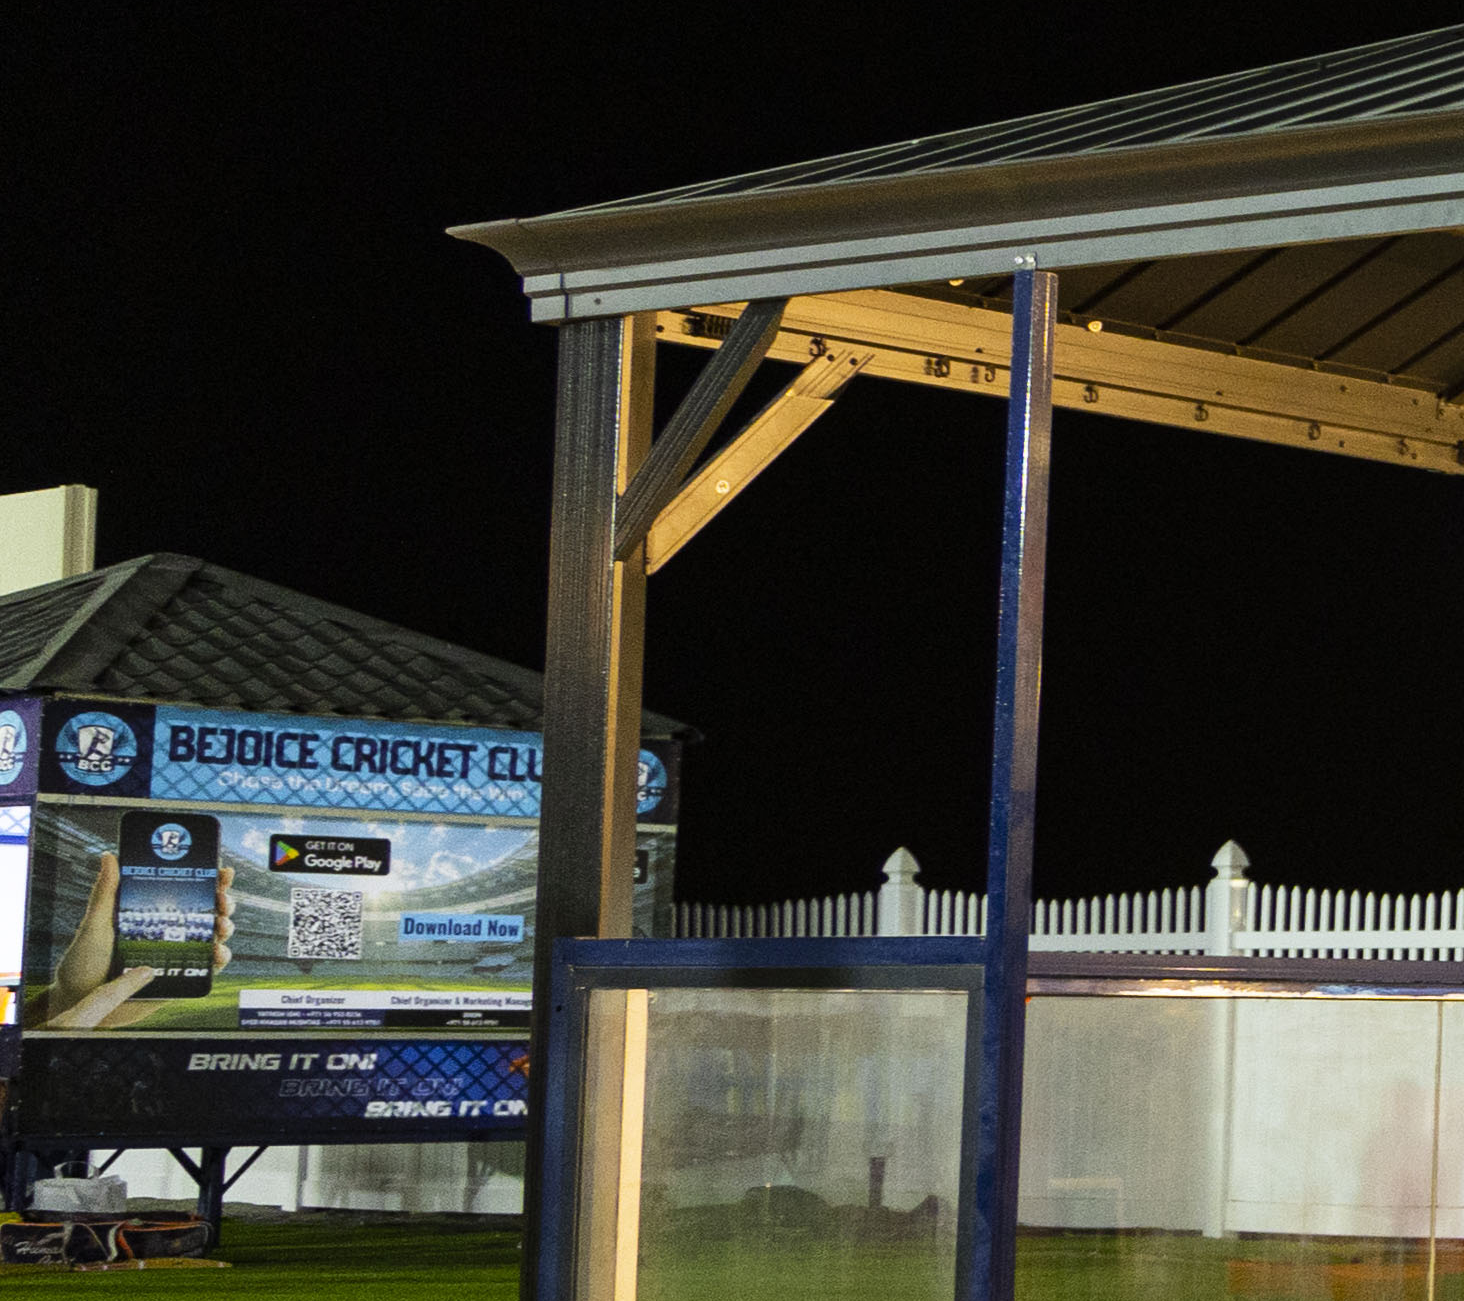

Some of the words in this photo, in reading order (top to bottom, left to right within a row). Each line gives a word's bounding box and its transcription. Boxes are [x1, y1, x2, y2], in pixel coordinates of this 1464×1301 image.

[169, 725, 319, 770] BEJOICE
[332, 736, 477, 779] CRICKET
[488, 745, 542, 782] CLU
[77, 760, 112, 772] BCC
[305, 841, 326, 850] GET
[327, 842, 336, 850] IT
[337, 842, 354, 852] ON
[304, 854, 353, 872] Google
[354, 856, 382, 872] Play
[403, 918, 482, 936] Download
[487, 920, 520, 937] Now
[505, 997, 532, 1008] Manag
[188, 1054, 282, 1071] BRING
[288, 1054, 320, 1071] IT
[326, 1054, 377, 1071] ON!
[280, 1078, 370, 1098] BRING
[377, 1078, 407, 1096] IT
[364, 1100, 452, 1118] BRING
[458, 1100, 489, 1117] IT
[494, 1100, 529, 1116] ON
